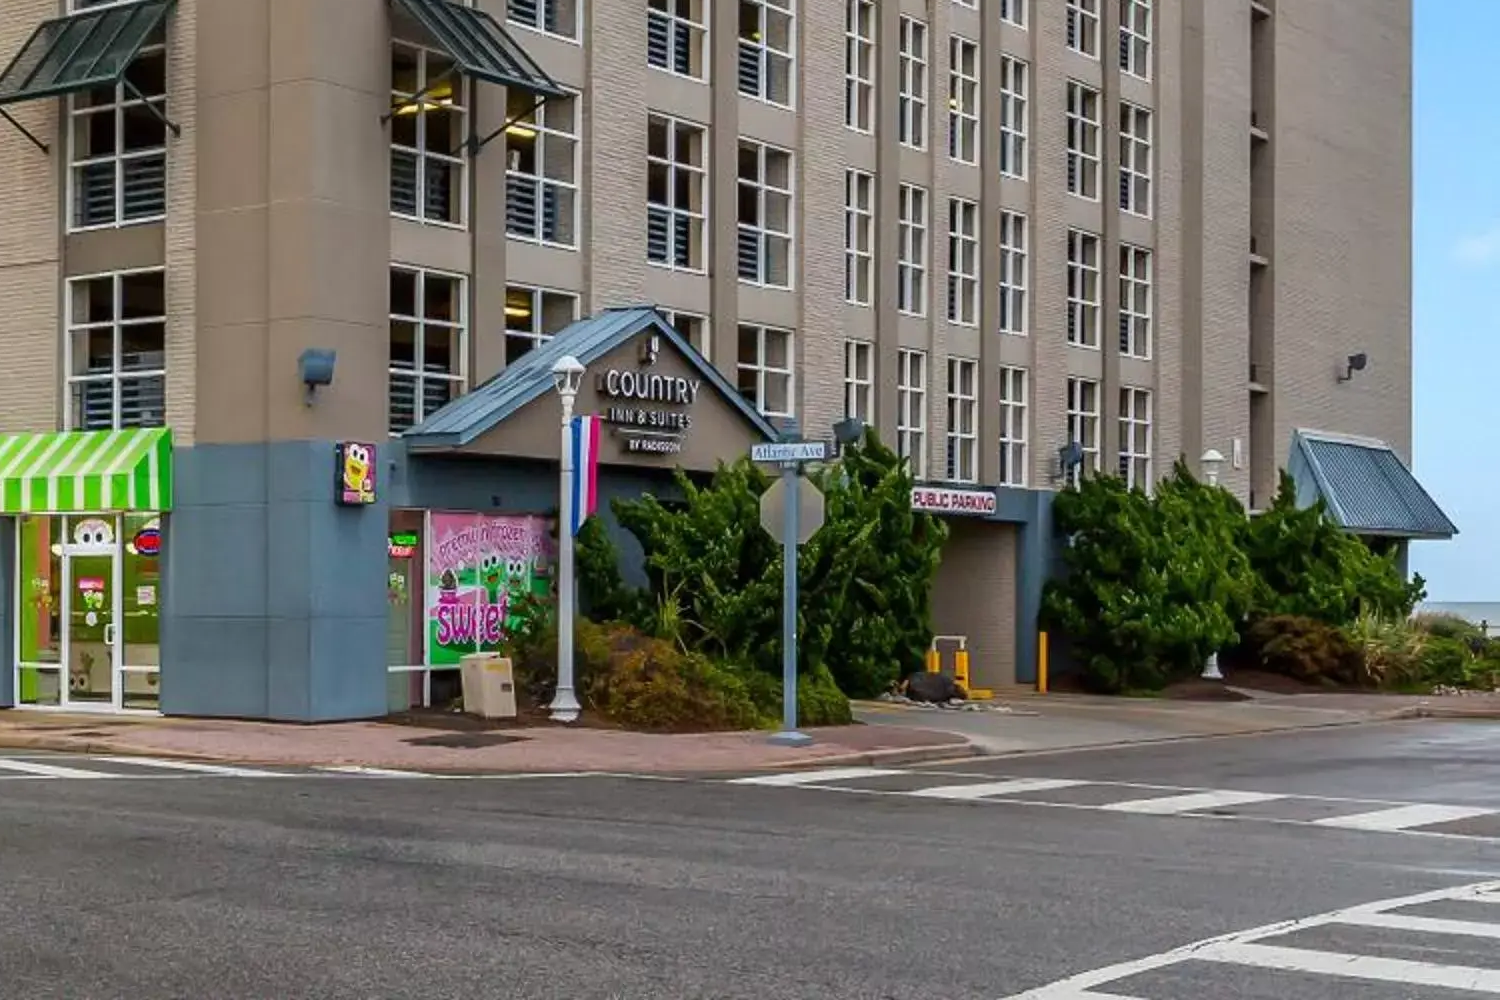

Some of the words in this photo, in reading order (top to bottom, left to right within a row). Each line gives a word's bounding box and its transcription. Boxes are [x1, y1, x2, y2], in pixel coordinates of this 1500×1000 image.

[607, 369, 700, 404] COUNTRY
[611, 407, 634, 423] INN
[637, 409, 647, 425] &
[650, 411, 693, 429] SUITES
[756, 444, 796, 459] Atlantic
[801, 443, 824, 457] Ave
[913, 491, 949, 508] PUBLIC
[951, 493, 995, 511] PARKING
